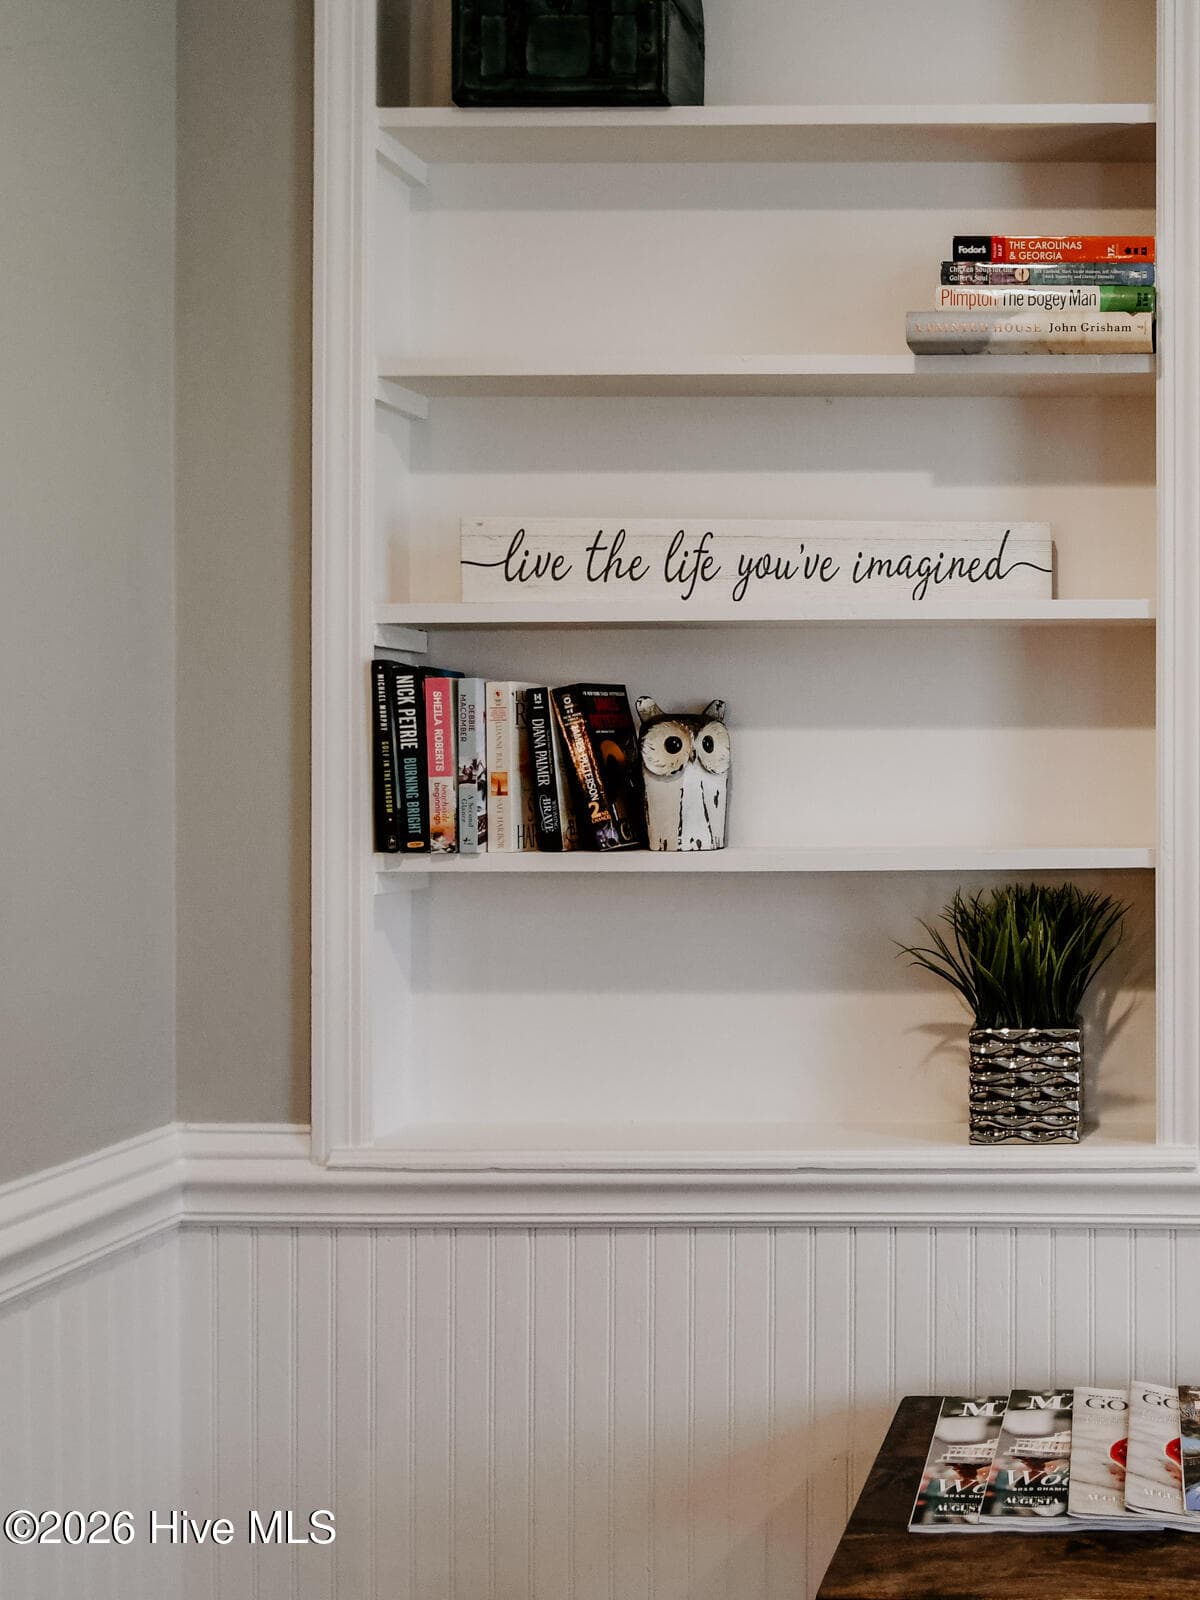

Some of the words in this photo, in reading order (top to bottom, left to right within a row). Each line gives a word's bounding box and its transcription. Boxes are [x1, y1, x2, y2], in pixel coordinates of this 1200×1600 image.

[957, 245, 987, 254] Fodor's
[1009, 241, 1027, 250] THE
[1028, 240, 1083, 250] CAROLINAS
[1009, 251, 1016, 260] &
[1018, 251, 1063, 260] GEORGIA
[949, 265, 974, 273] Chicken
[941, 289, 998, 310] Plimpton
[1001, 290, 1024, 307] The
[1027, 289, 1067, 310] Bogey
[1069, 289, 1097, 307] Man
[994, 322, 1042, 333] HOUSE
[1049, 322, 1077, 333] John
[1081, 321, 1132, 333] Grisham
[504, 528, 572, 583] live
[586, 529, 650, 583] the
[664, 529, 721, 601] life
[732, 543, 841, 602] you've
[852, 529, 1040, 601] imagined
[396, 674, 416, 705] NICK
[432, 690, 444, 726] SHEILA
[460, 694, 468, 743] MACOMBER
[468, 704, 476, 732] DEBBIE
[398, 708, 419, 750] PETRIE
[531, 718, 547, 749] DIANA
[433, 729, 446, 772] ROBERTS
[403, 757, 420, 799] BURNING
[534, 750, 551, 787] PALMER
[576, 752, 600, 801] PATTERSON
[406, 801, 422, 834] BRIGHT
[432, 782, 442, 825] beginnings
[541, 798, 555, 833] BRAVE
[1003, 1495, 1060, 1506] AUGUSTA
